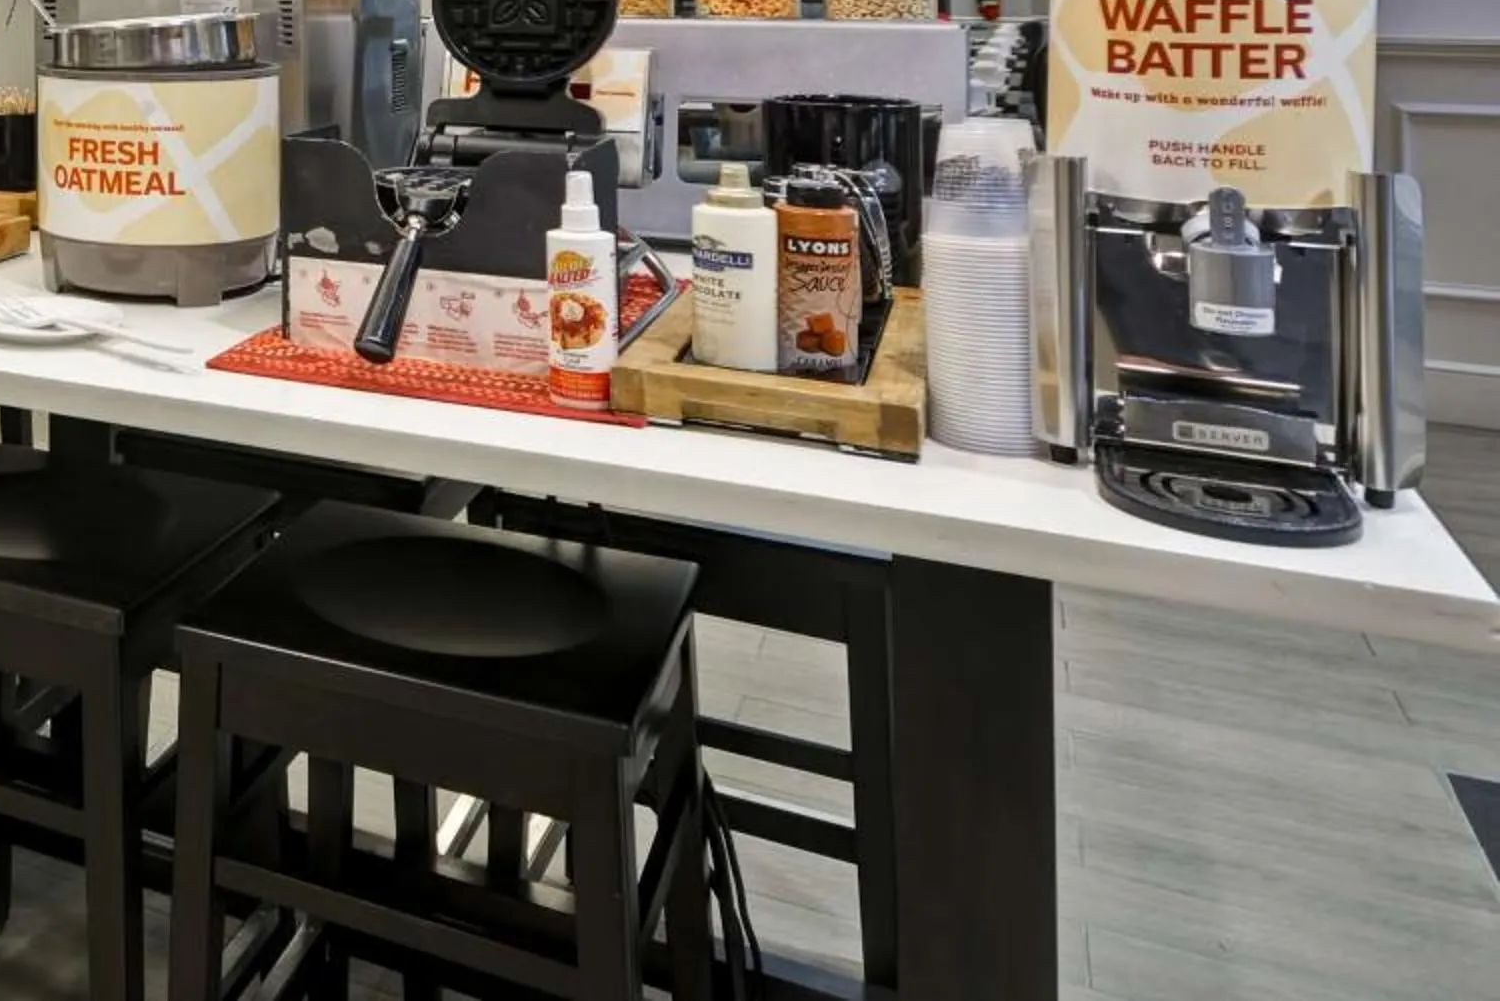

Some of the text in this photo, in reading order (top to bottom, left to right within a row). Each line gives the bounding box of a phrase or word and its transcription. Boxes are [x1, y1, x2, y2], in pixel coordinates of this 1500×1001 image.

[1107, 39, 1306, 80] BATTER
[1124, 92, 1140, 104] up
[1145, 91, 1178, 104] with
[1182, 95, 1193, 104] a
[1197, 94, 1275, 108] wonderful
[68, 137, 159, 166] FRESH
[1148, 139, 1266, 156] PUSH HANDLE
[1152, 153, 1195, 168] BACK
[1200, 157, 1223, 169] TO
[54, 164, 186, 196] OATMEAL
[787, 238, 850, 255] LYONS
